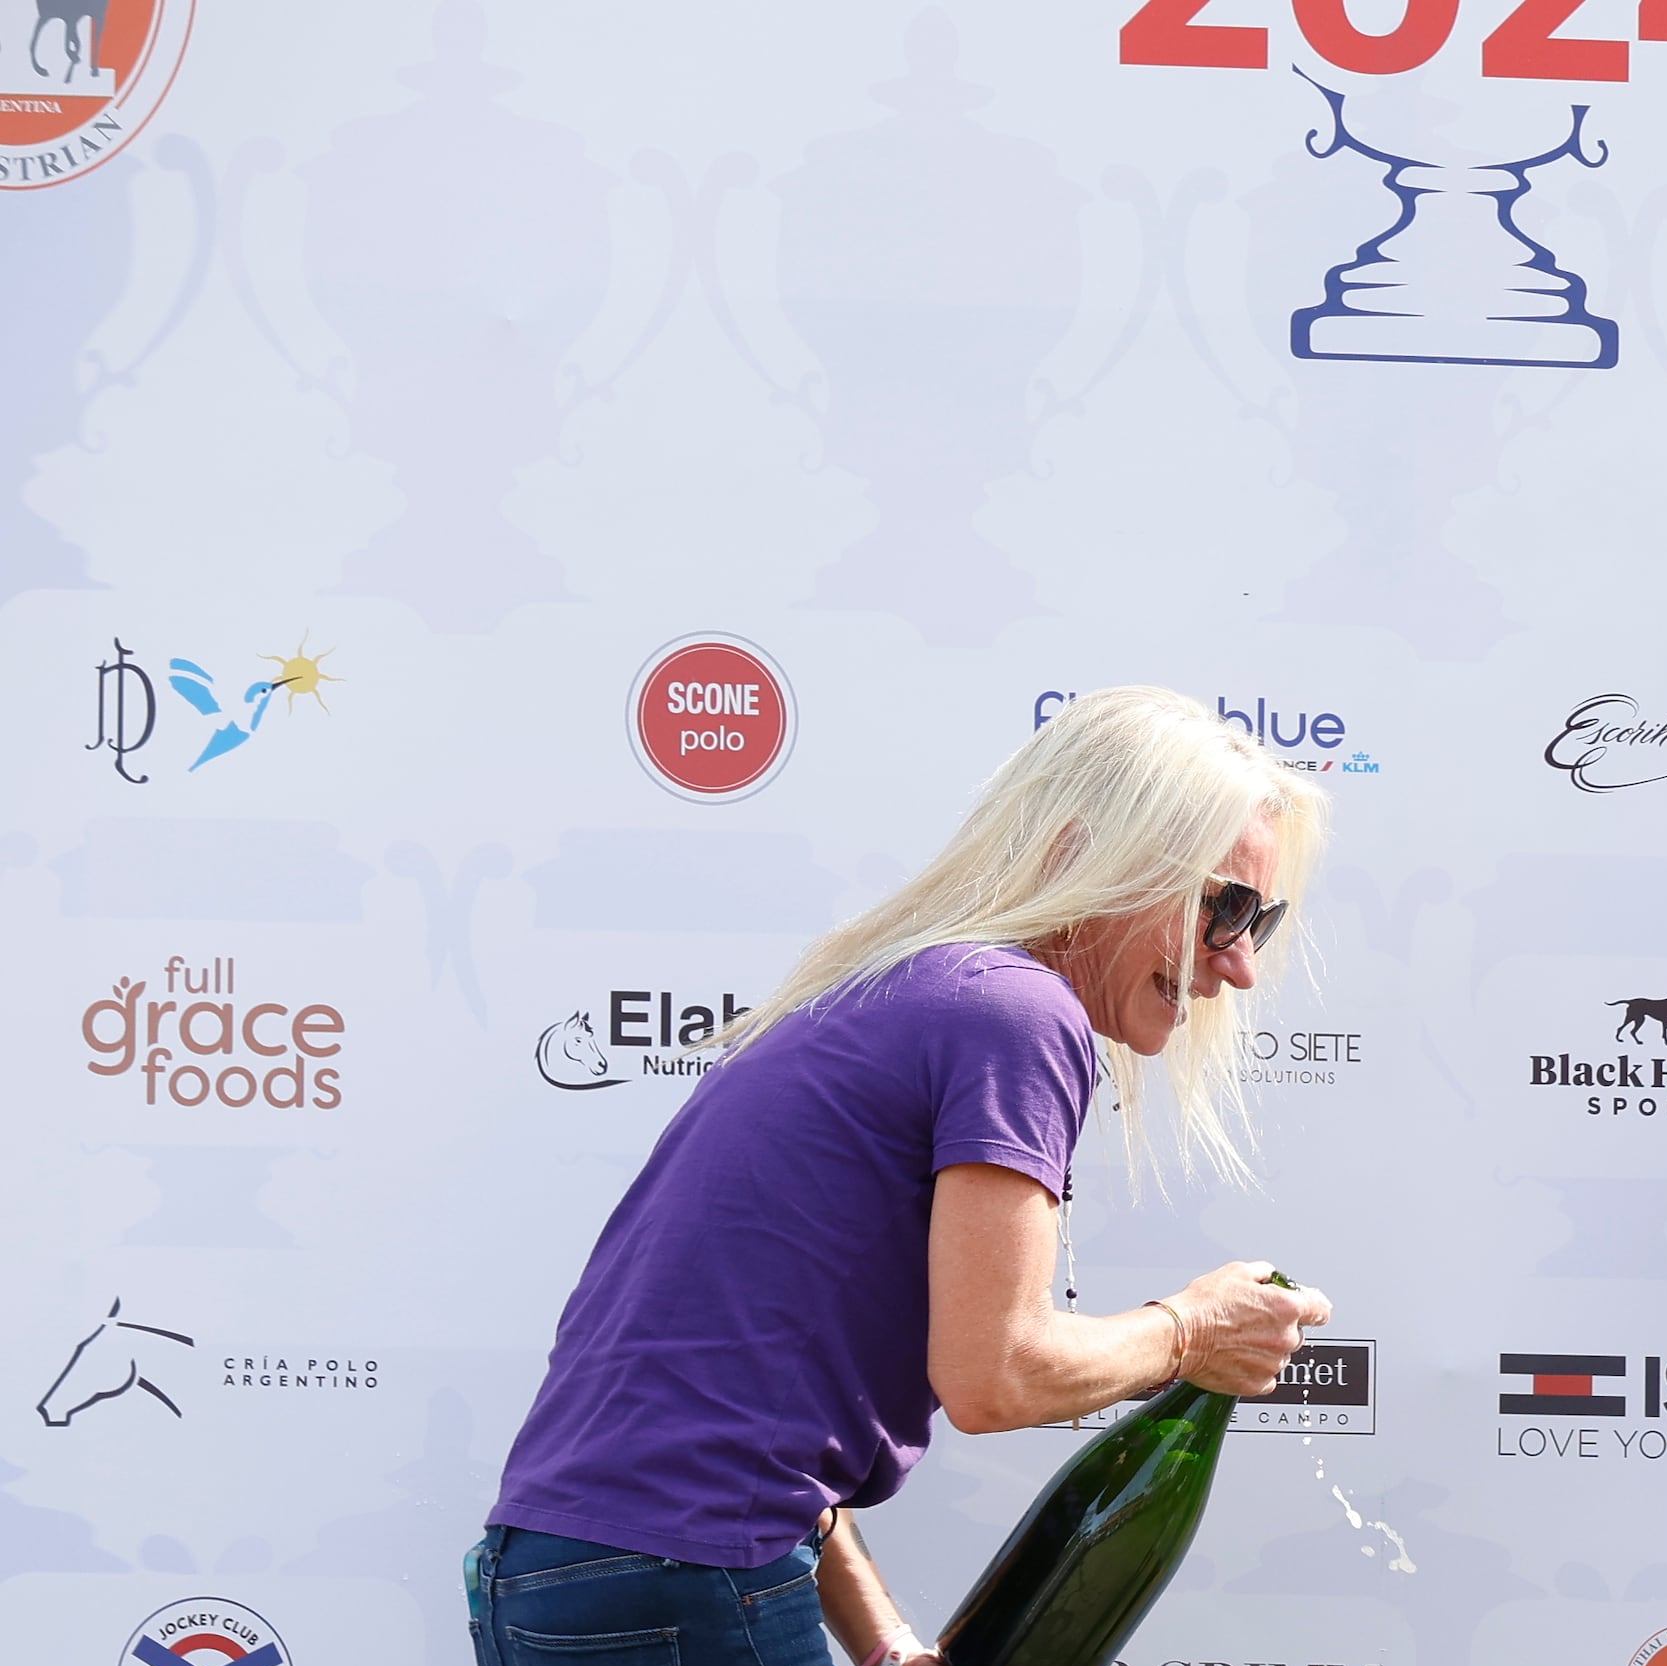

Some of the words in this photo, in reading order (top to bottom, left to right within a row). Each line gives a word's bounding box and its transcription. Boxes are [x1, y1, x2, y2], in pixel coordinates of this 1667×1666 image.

[667, 681, 760, 716] SCONE
[680, 724, 745, 756] polo
[1341, 762, 1380, 774] KLM
[164, 955, 236, 995] full
[81, 986, 346, 1077] grace
[1289, 1032, 1362, 1063] SIETE
[141, 1046, 344, 1111] foods
[1529, 1053, 1645, 1088] Black
[223, 1355, 289, 1371] CRÍA
[308, 1359, 378, 1373] POLO
[223, 1374, 378, 1389] ARGENTINO
[1497, 1427, 1600, 1458] LOVE
[158, 1612, 220, 1642] JOCKEY
[222, 1616, 260, 1647] CLUB
